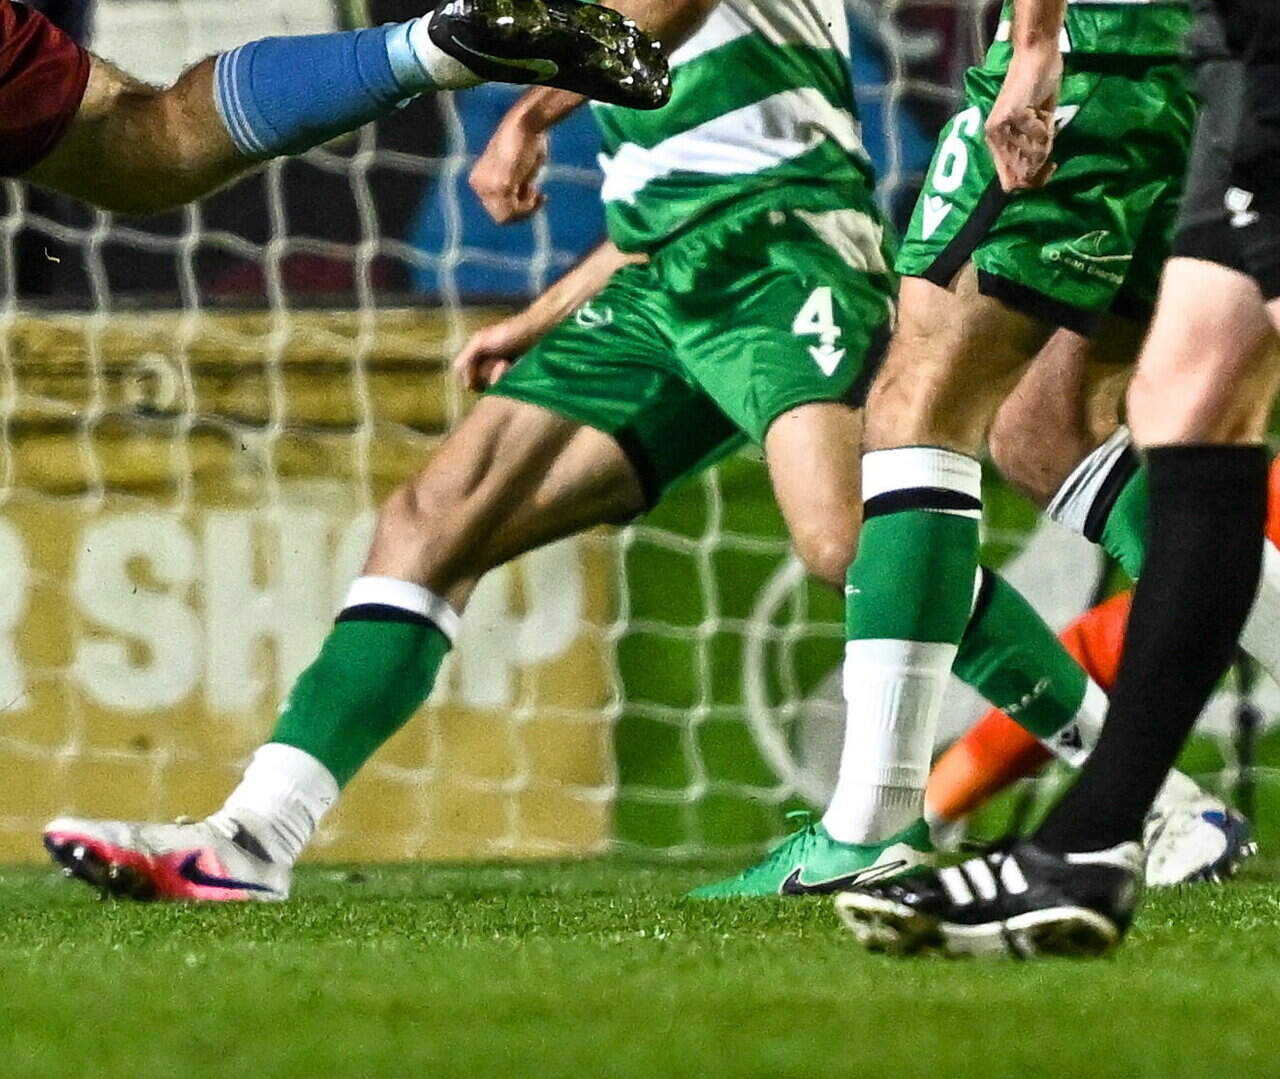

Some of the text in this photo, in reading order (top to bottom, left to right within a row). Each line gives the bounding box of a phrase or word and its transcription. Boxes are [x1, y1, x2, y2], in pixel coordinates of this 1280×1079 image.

[932, 105, 981, 193] 6
[792, 286, 841, 346] 4
[75, 508, 584, 714] SHP
